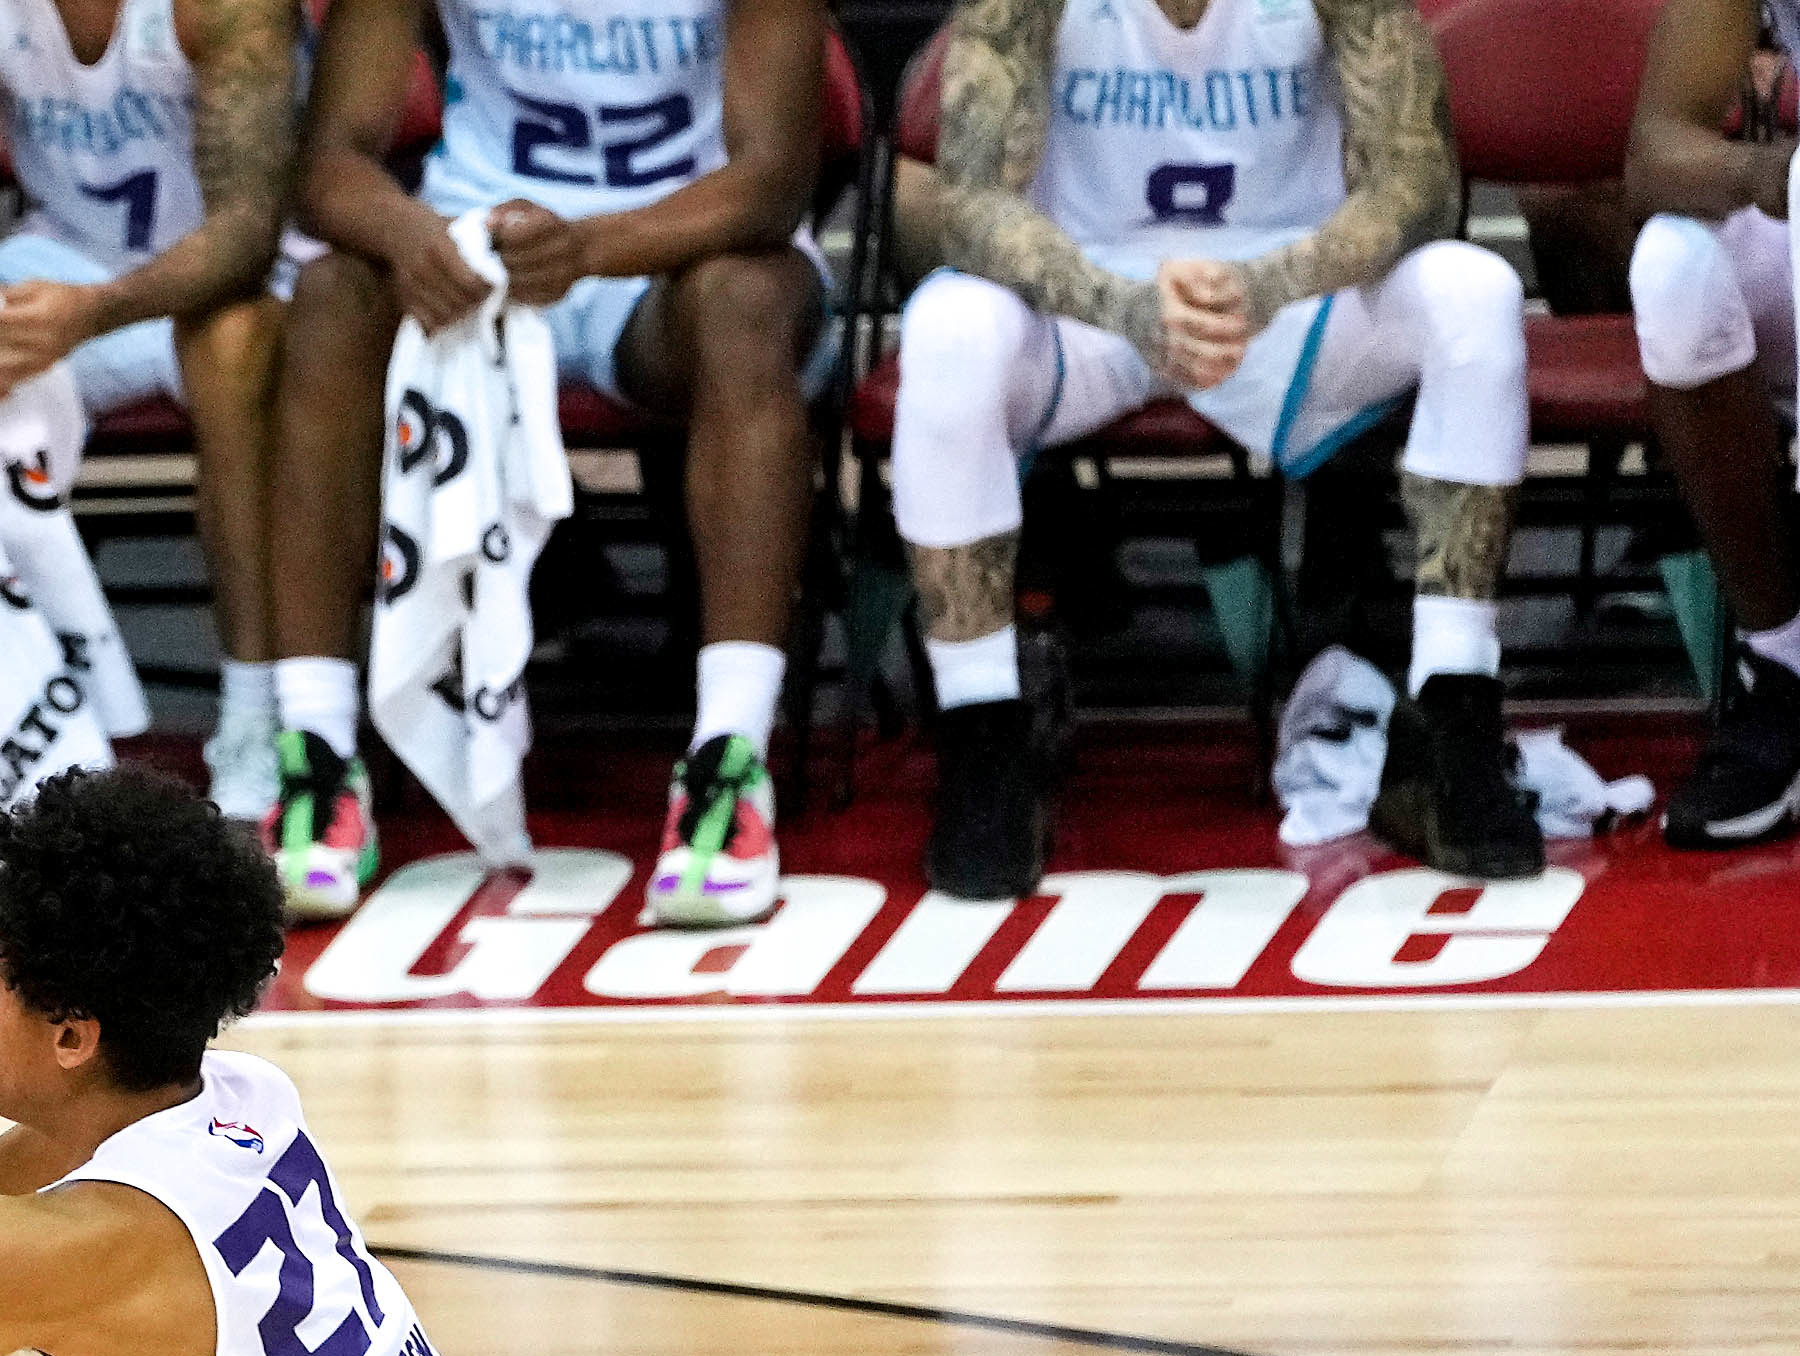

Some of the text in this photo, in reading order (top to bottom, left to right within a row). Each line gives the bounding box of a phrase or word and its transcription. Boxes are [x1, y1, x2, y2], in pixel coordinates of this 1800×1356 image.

[503, 90, 697, 187] 22
[1064, 66, 1308, 130] CHARLOTTE
[75, 165, 158, 250] 7
[303, 846, 1588, 1002] Game
